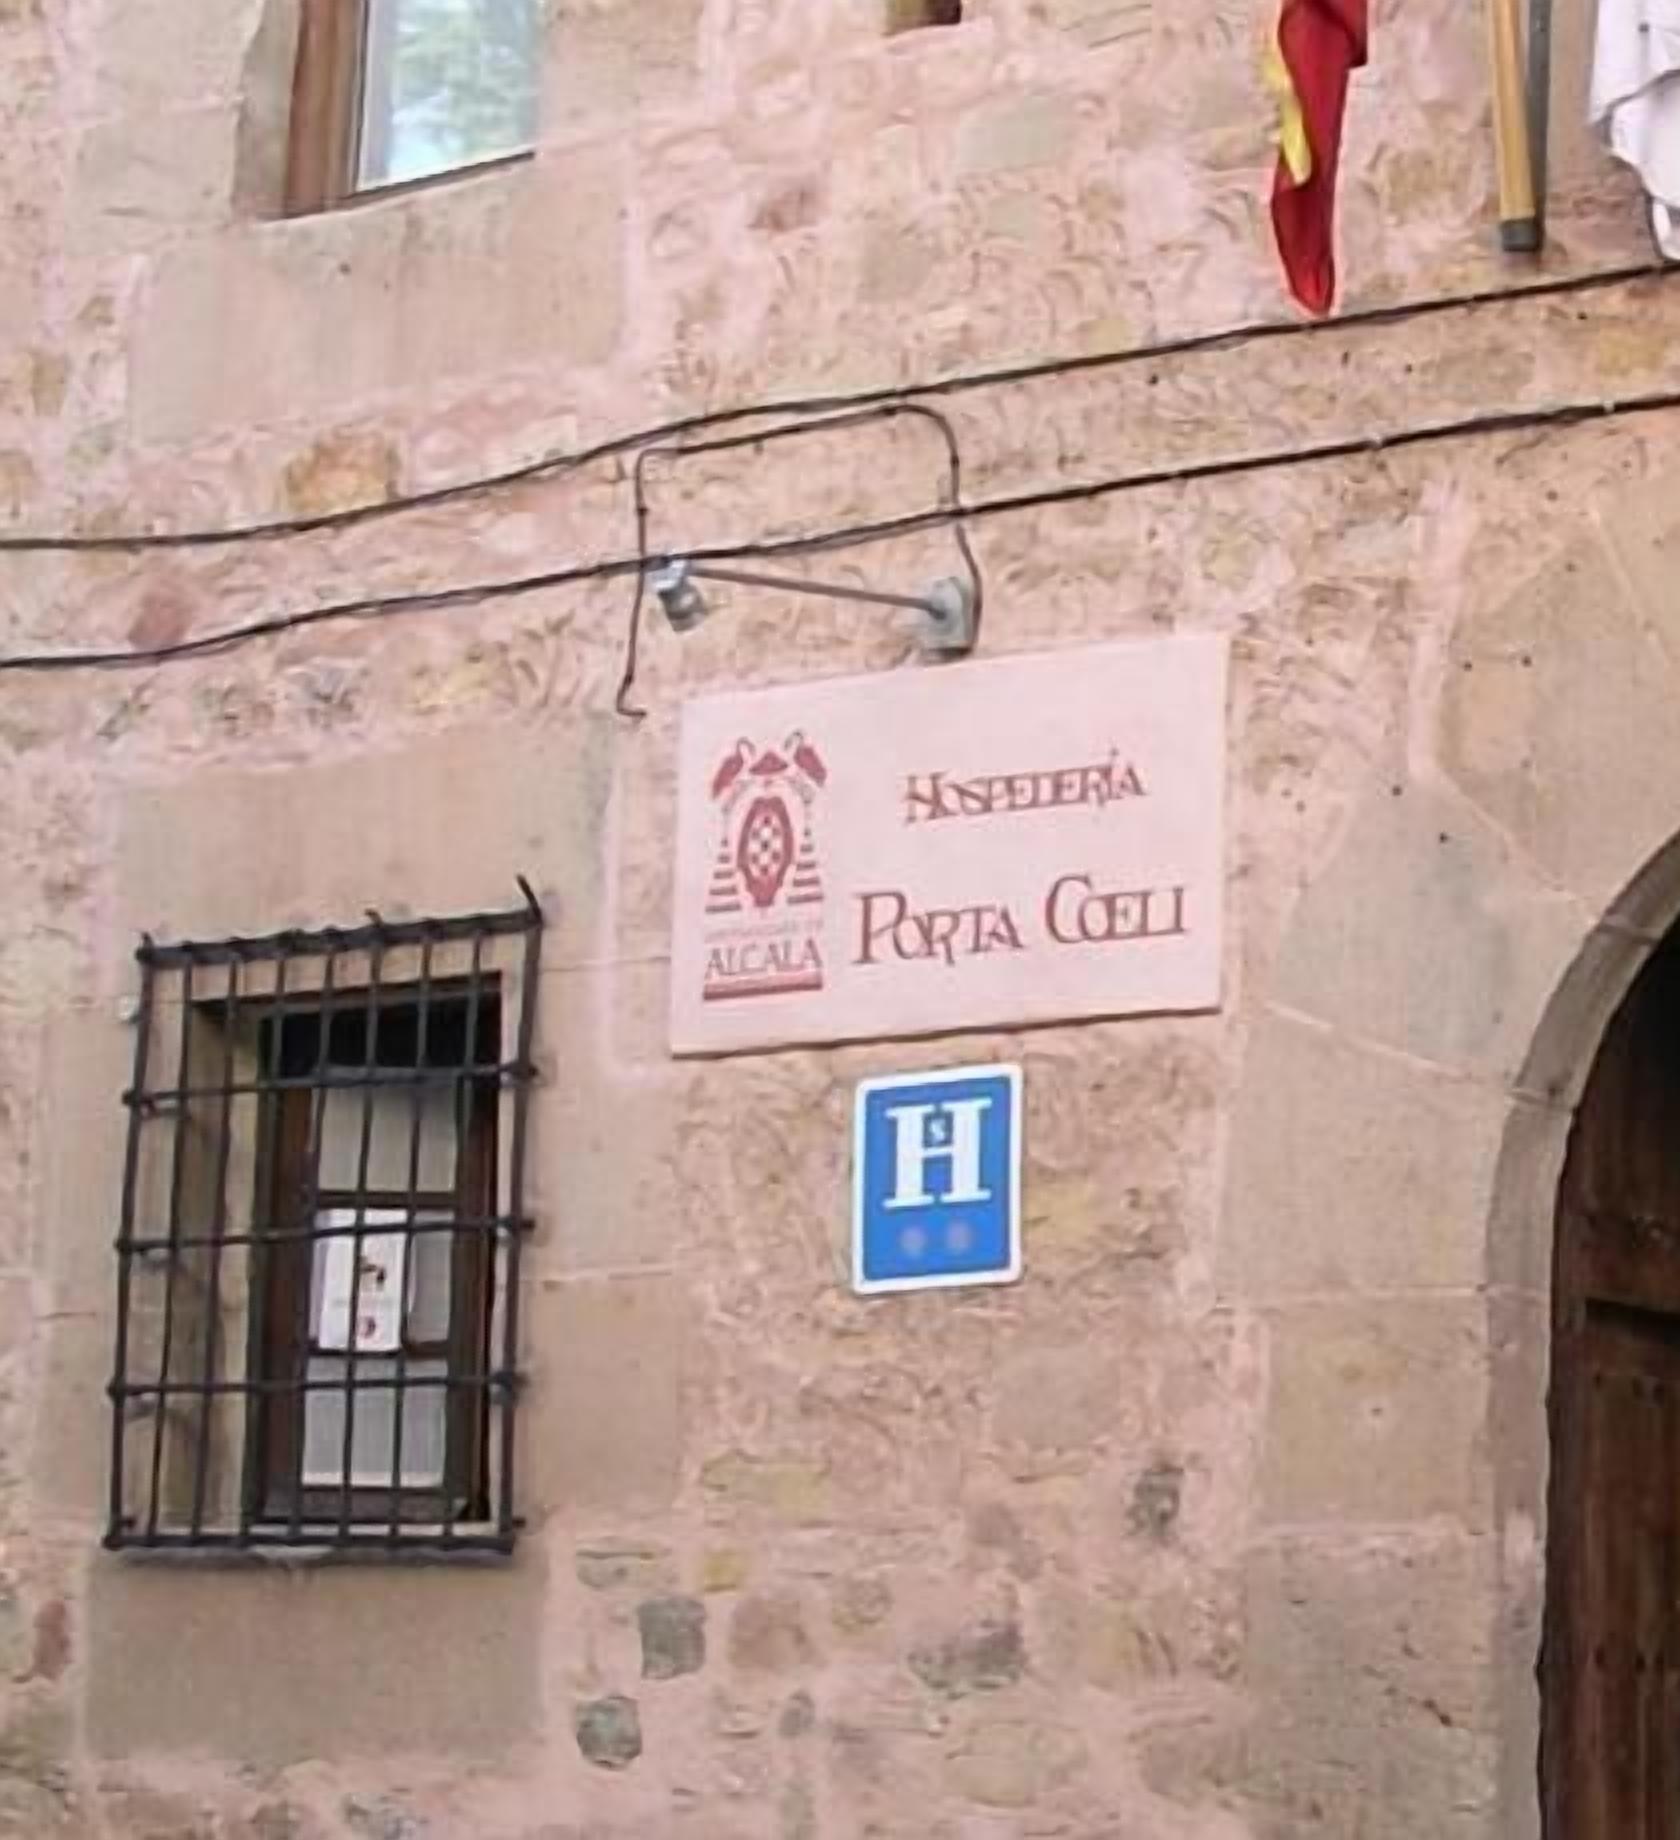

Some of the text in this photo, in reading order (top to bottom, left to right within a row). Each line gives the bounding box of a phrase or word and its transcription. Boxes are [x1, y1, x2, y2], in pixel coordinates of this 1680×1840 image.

[851, 875, 1188, 965] PORTA COELI
[882, 1097, 993, 1209] H
